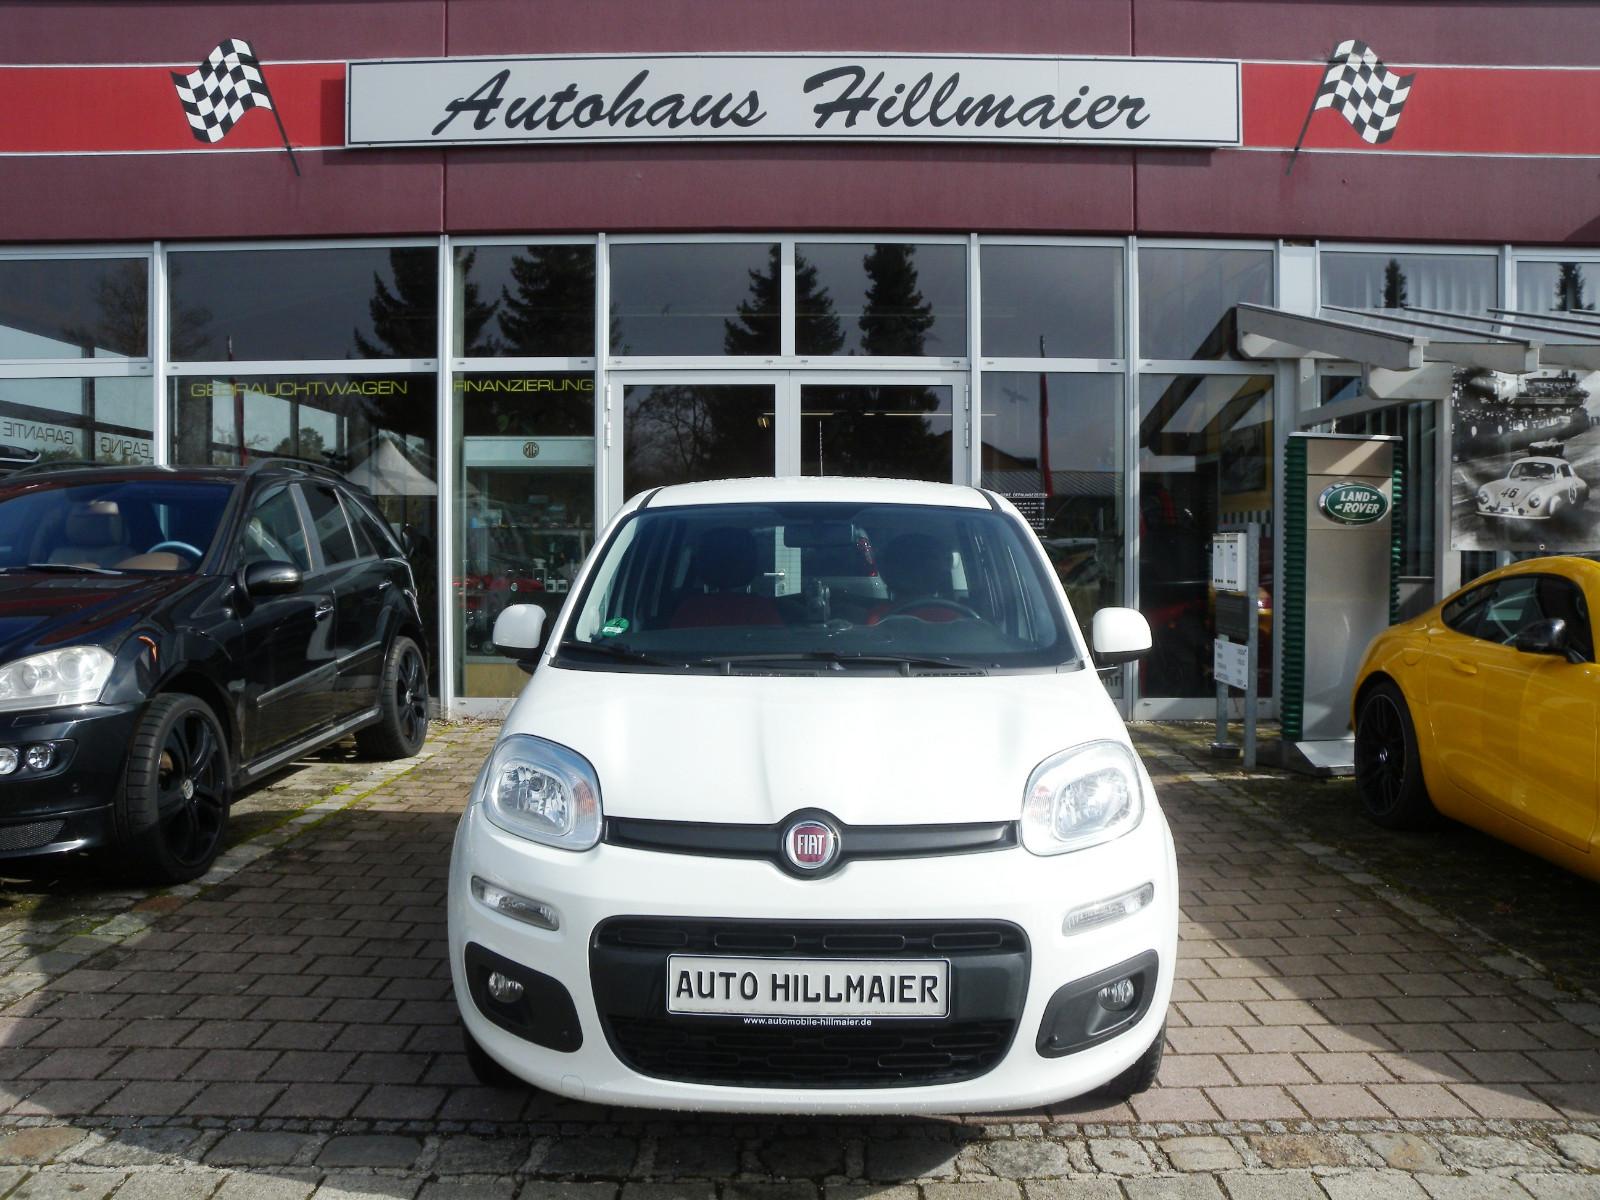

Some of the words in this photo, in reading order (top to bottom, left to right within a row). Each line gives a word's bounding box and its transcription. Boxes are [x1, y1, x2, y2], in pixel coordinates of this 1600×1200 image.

[431, 69, 767, 136] Autohaus
[802, 65, 1151, 130] Hillmaier
[190, 380, 408, 397] GEBRAUCHTWAGEN
[453, 378, 594, 392] FINANZIERUNG
[1340, 491, 1371, 502] LAND
[1501, 488, 1519, 498] 46
[1342, 502, 1380, 514] ROVER
[797, 834, 825, 855] FIAT
[675, 970, 759, 1000] AUTO
[771, 973, 939, 1003] HILLMAIER
[743, 1016, 872, 1027] www.automobile-hillmaier.de
